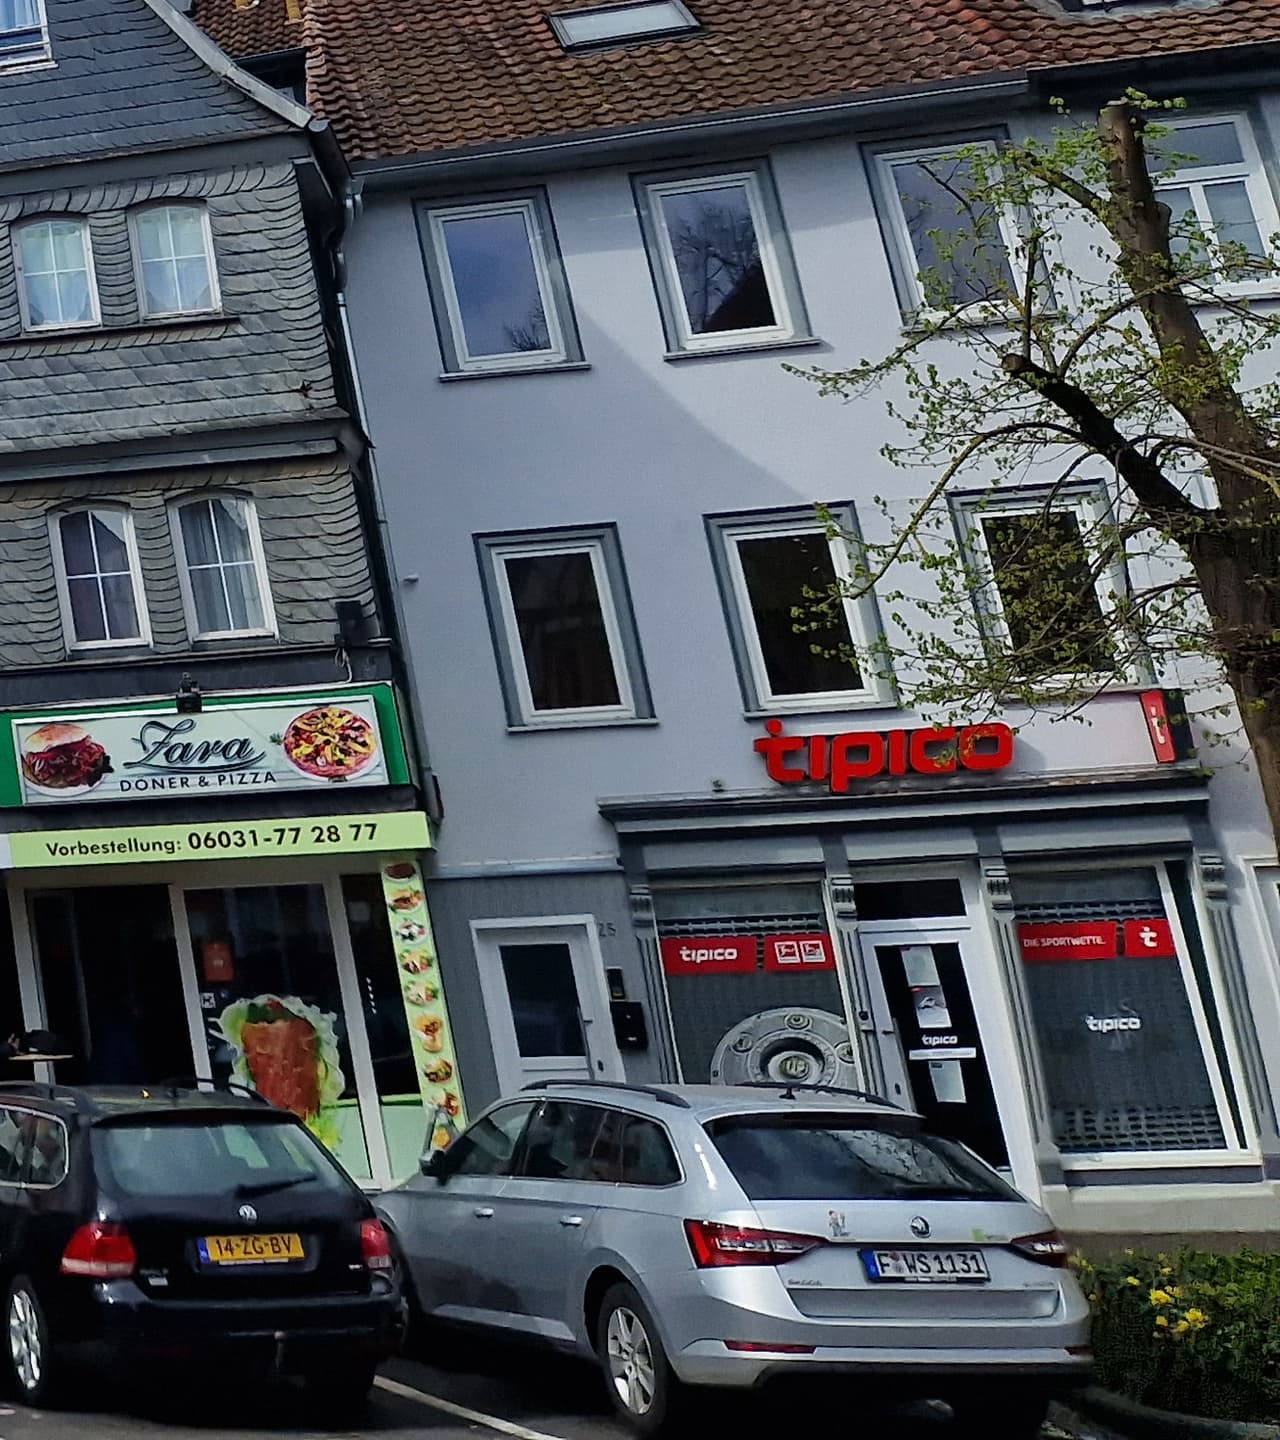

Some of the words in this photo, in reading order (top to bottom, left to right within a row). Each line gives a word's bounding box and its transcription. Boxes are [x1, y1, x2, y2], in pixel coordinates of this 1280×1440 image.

[123, 718, 266, 773] Zara
[753, 718, 1015, 793] tipico
[198, 775, 209, 788] &
[219, 771, 277, 786] PIZZA
[46, 839, 182, 857] Vorbestellung:
[188, 827, 301, 850] 06031-77
[311, 825, 341, 843] 28
[349, 823, 377, 841] 77
[679, 946, 738, 963] tipico
[1085, 1016, 1141, 1033] tipico
[922, 1035, 958, 1046] tipico
[216, 1236, 292, 1256] 14-ZG-BV
[877, 1253, 892, 1274] F
[904, 1254, 930, 1274] WS
[934, 1255, 985, 1274] 1131
